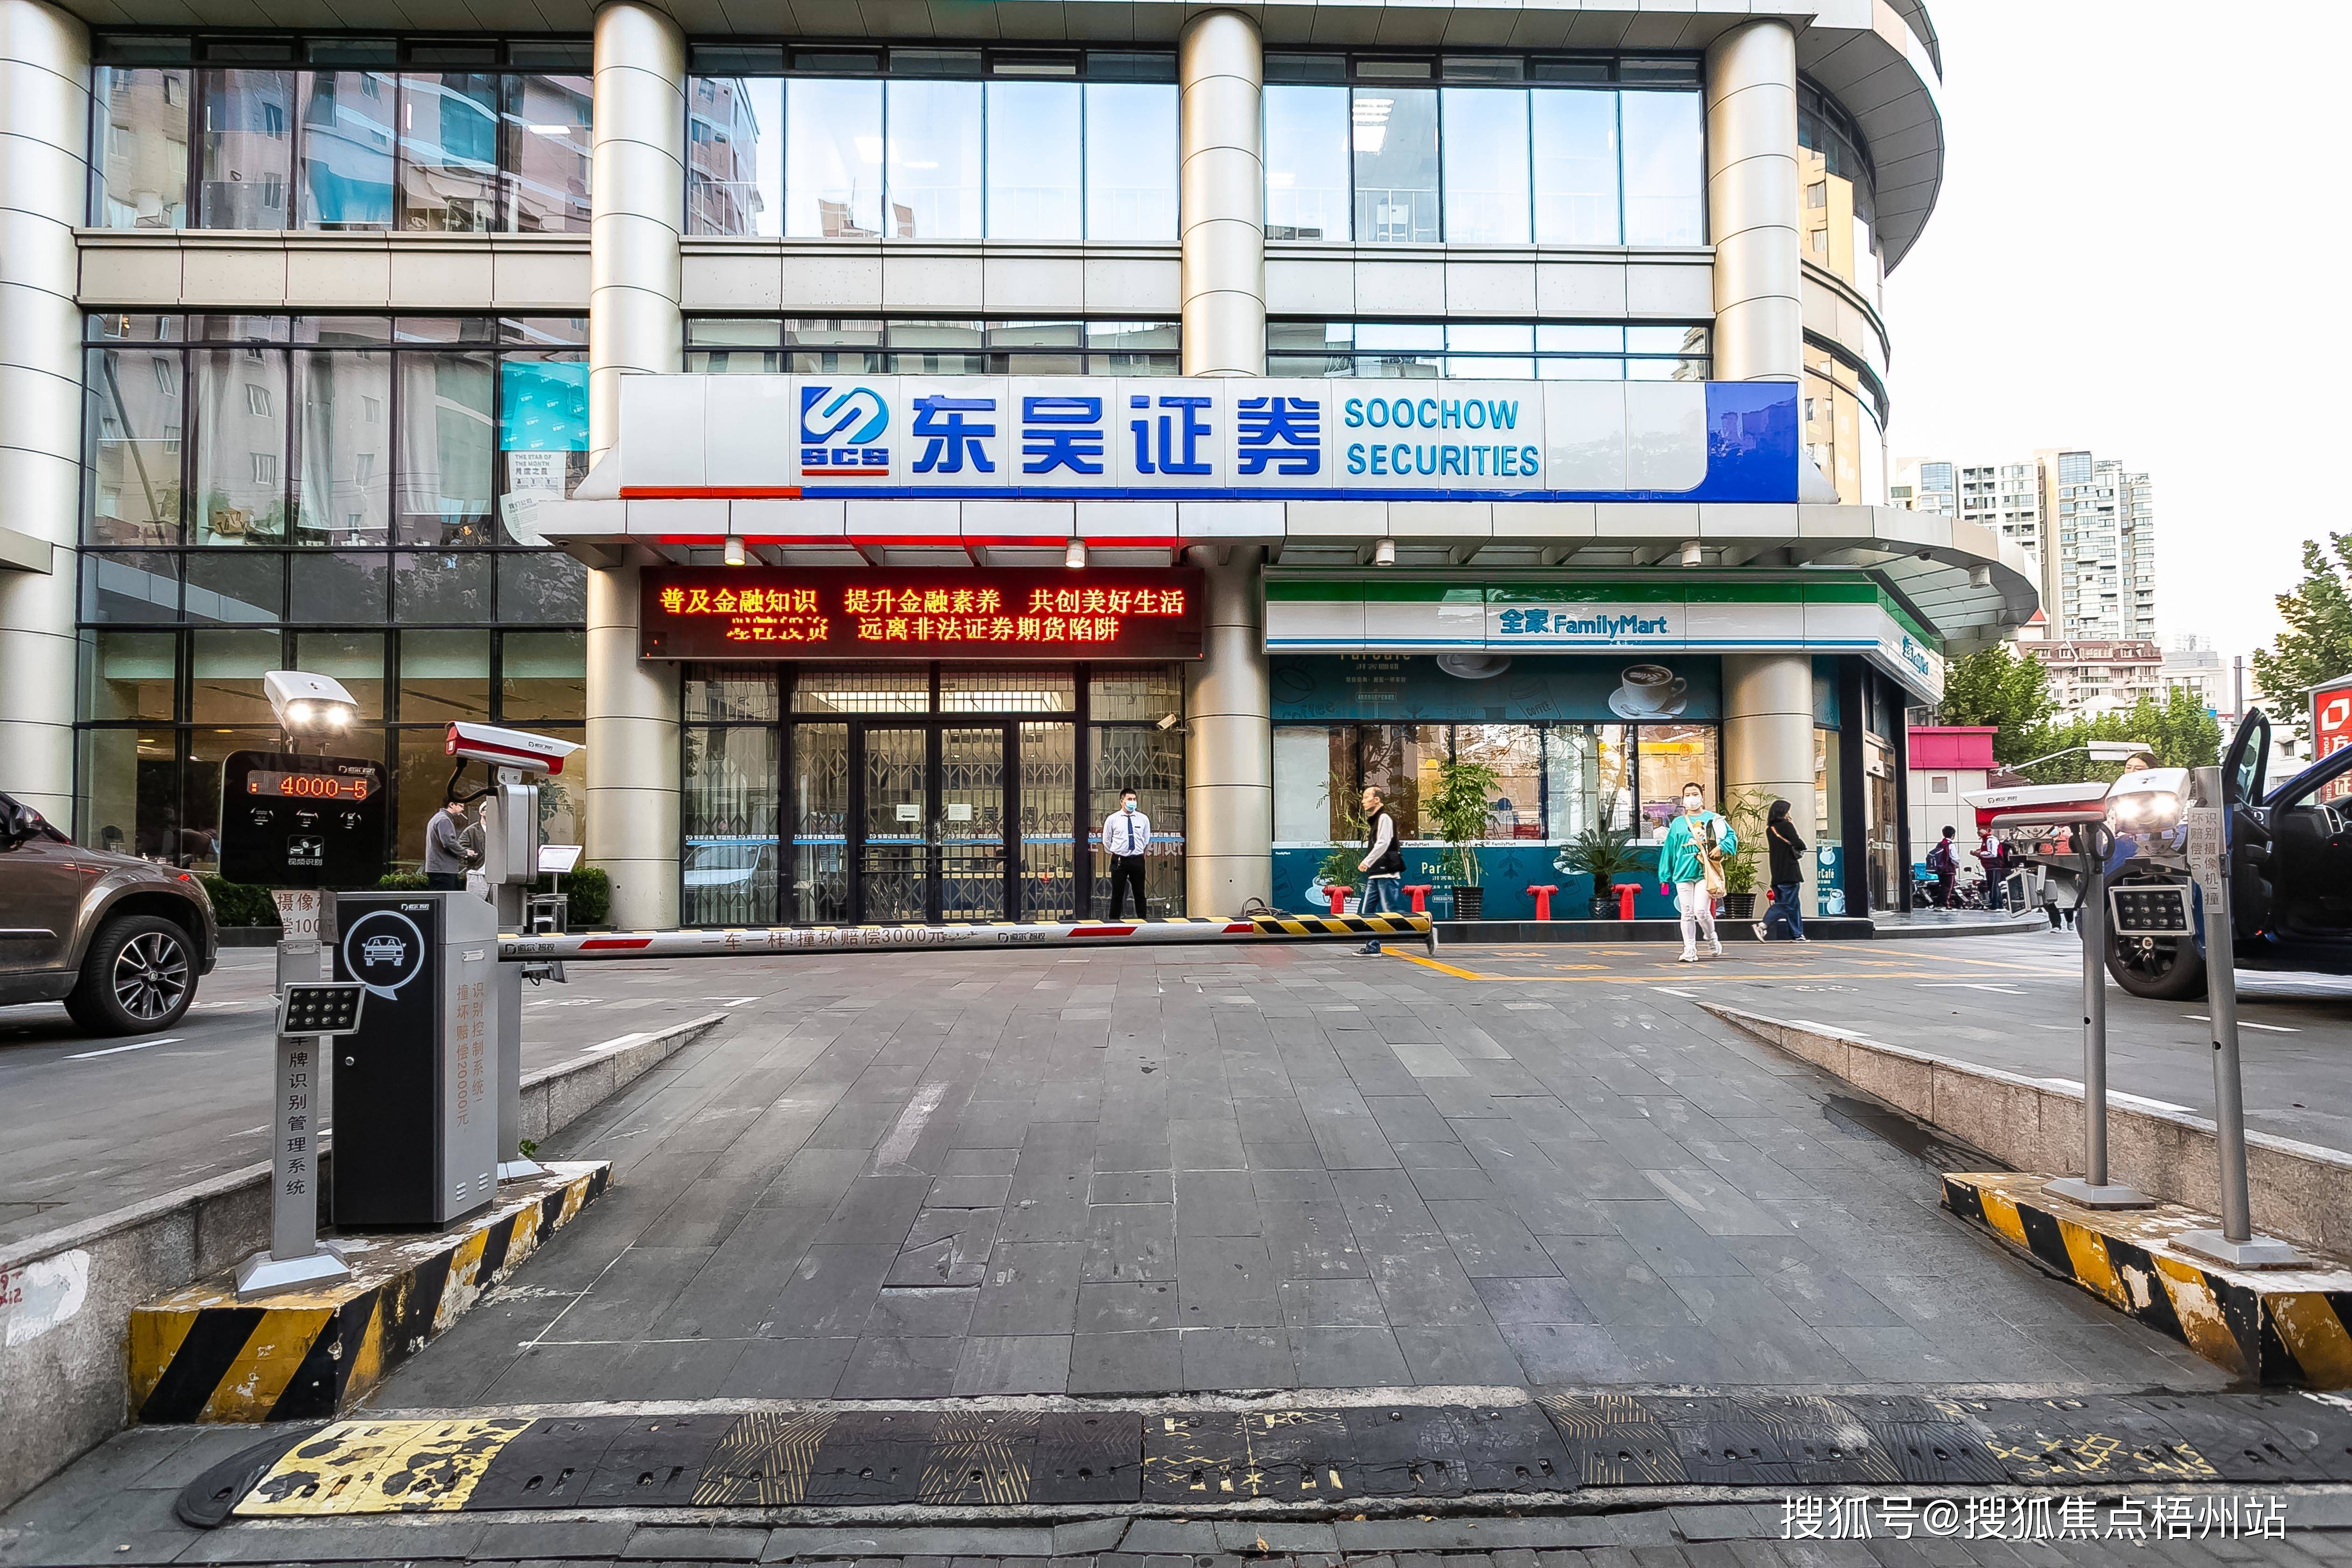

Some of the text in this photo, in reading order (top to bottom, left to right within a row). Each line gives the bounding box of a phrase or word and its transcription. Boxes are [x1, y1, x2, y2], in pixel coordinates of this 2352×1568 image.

[1344, 397, 1519, 429] SOOCHOW
[912, 394, 1321, 475] 东吴证券
[801, 448, 889, 466] SCS
[1346, 442, 1539, 477] SECURITIES
[660, 588, 1184, 614] 普及金融知识 提升金融素养 共创美好生活
[858, 616, 1119, 641] 远离非法证券期货陷阱
[1499, 609, 1668, 638] 全家 FamilyMart
